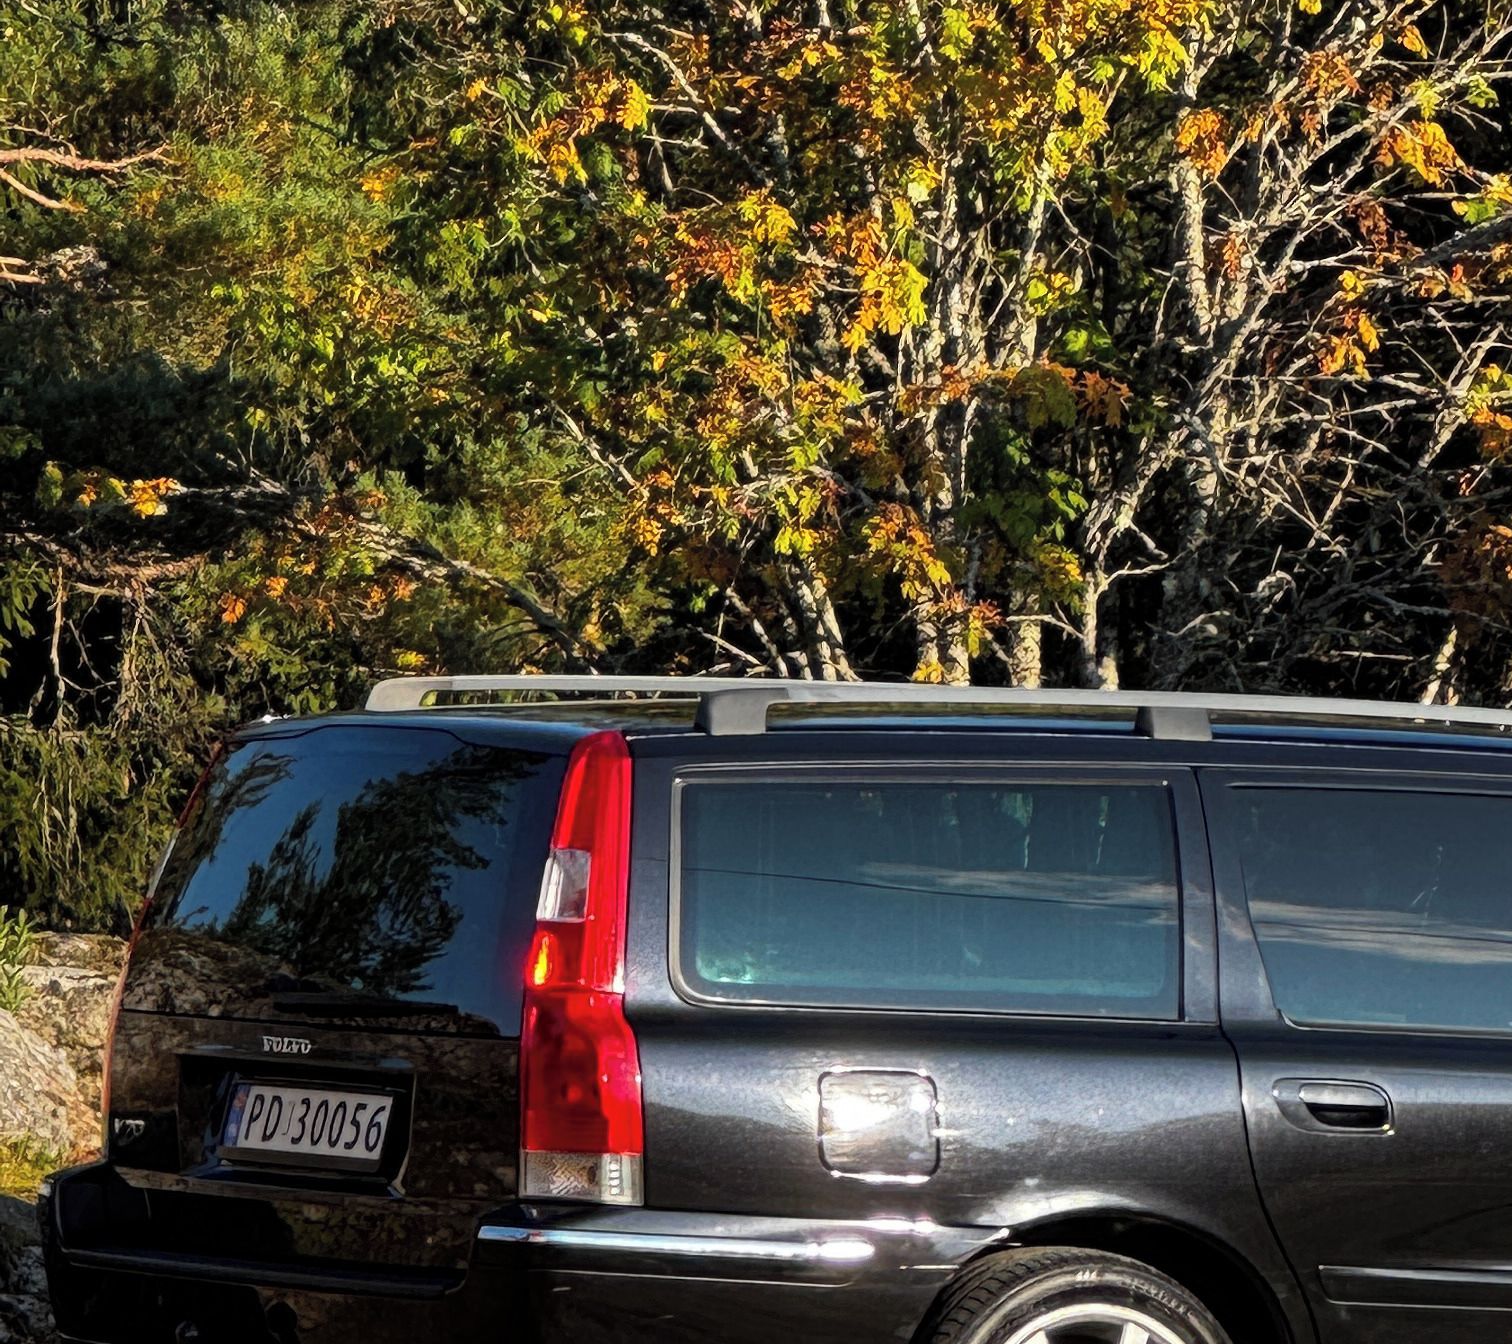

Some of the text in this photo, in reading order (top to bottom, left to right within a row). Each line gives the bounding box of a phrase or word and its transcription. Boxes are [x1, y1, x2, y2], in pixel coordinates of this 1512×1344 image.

[262, 1035, 312, 1055] VOLVO
[244, 1093, 387, 1153] PD 30056
